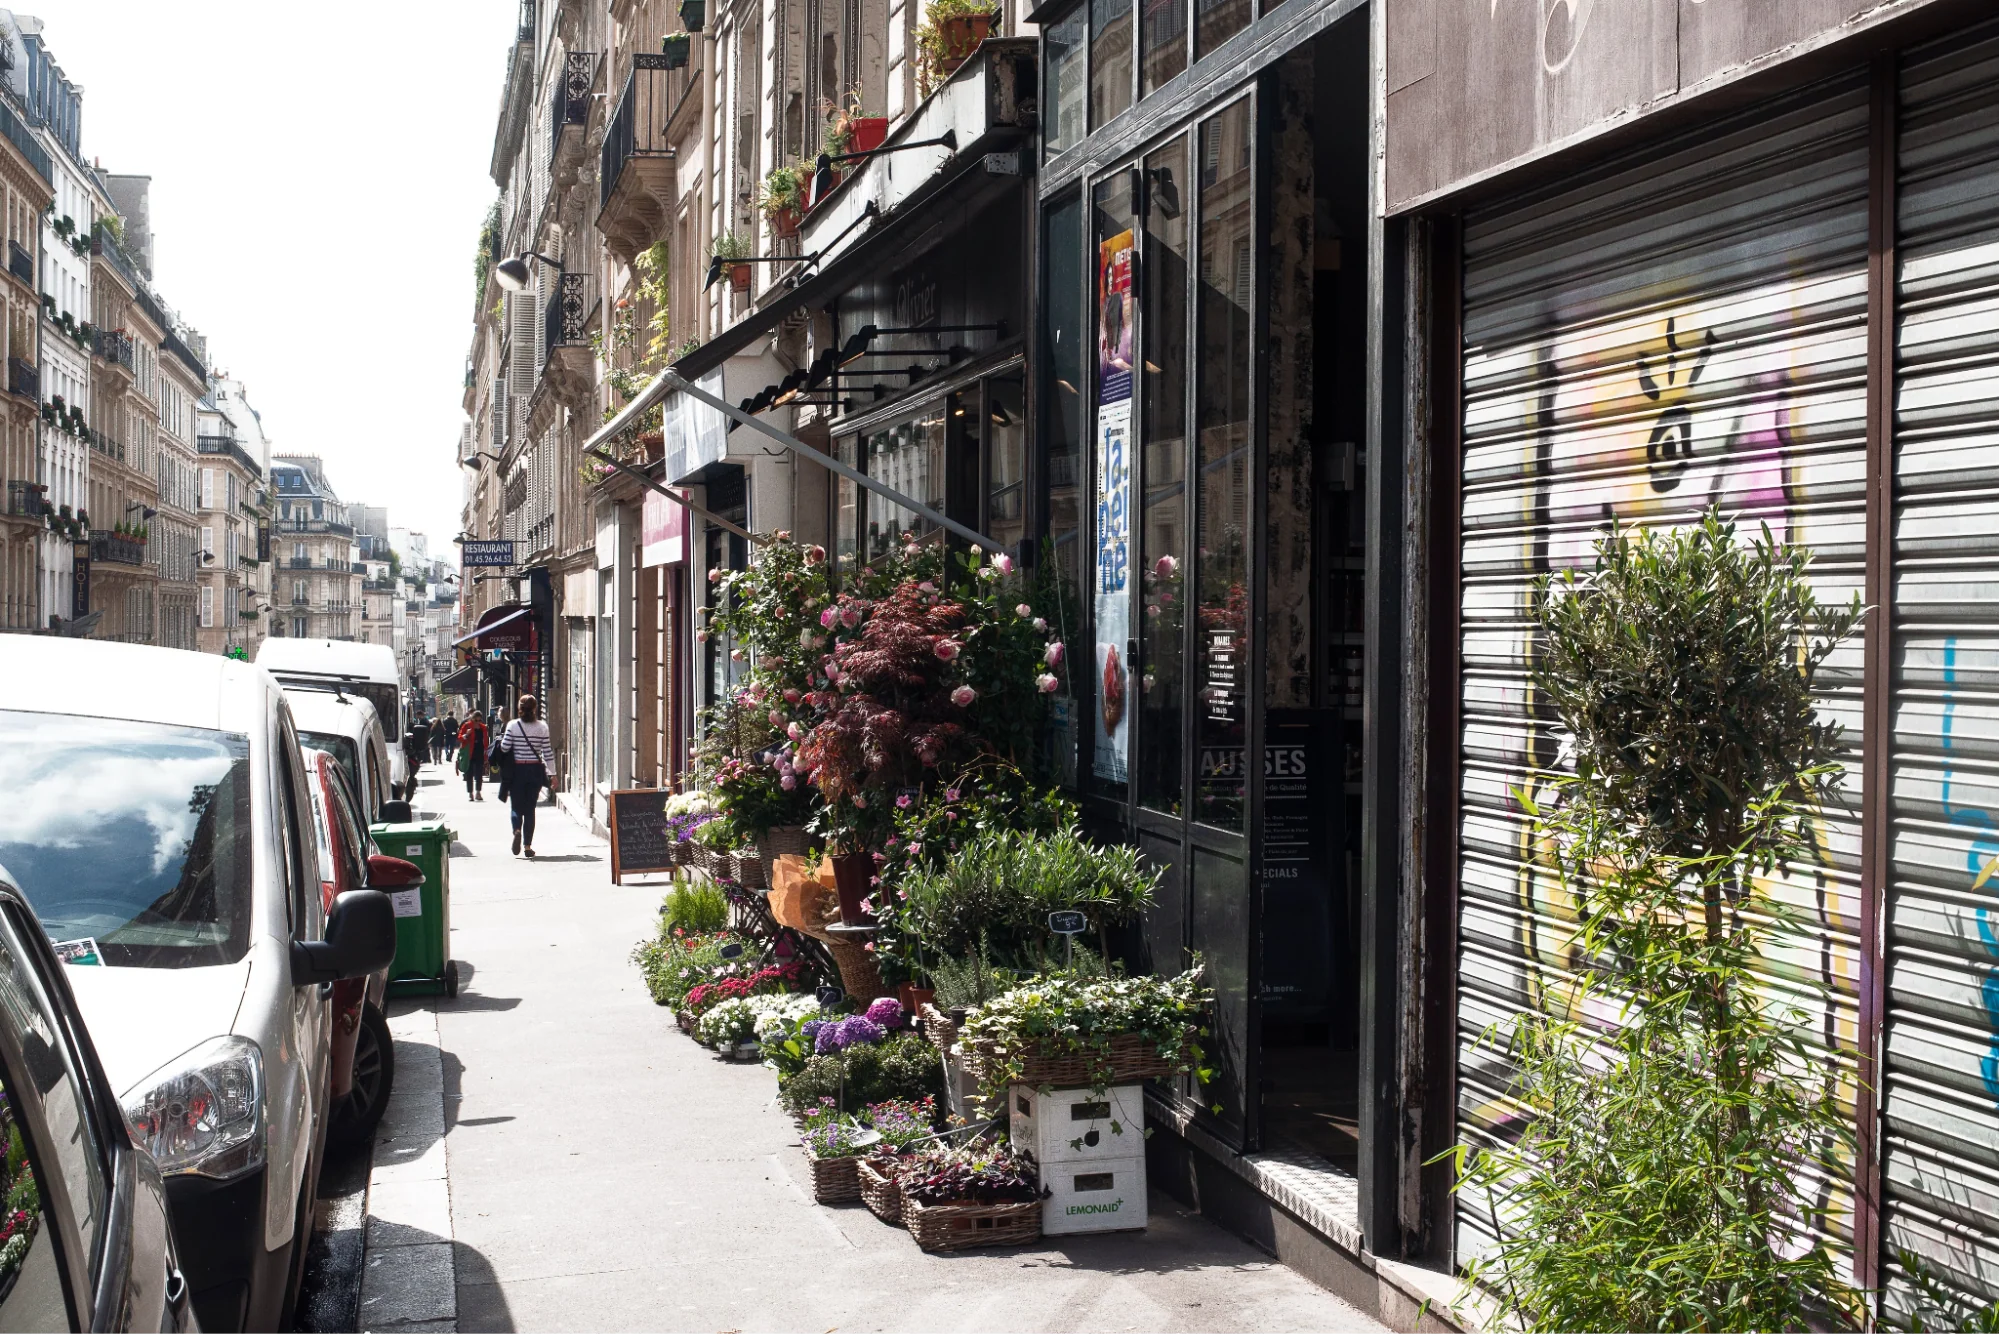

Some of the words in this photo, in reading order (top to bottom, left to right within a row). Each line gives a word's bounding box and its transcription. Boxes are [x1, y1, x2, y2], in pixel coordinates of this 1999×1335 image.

[465, 544, 511, 553] RESTAURANT
[465, 555, 511, 563] 01.45.26.64.52
[76, 562, 86, 611] HOTEL
[1280, 783, 1307, 792] Qualité
